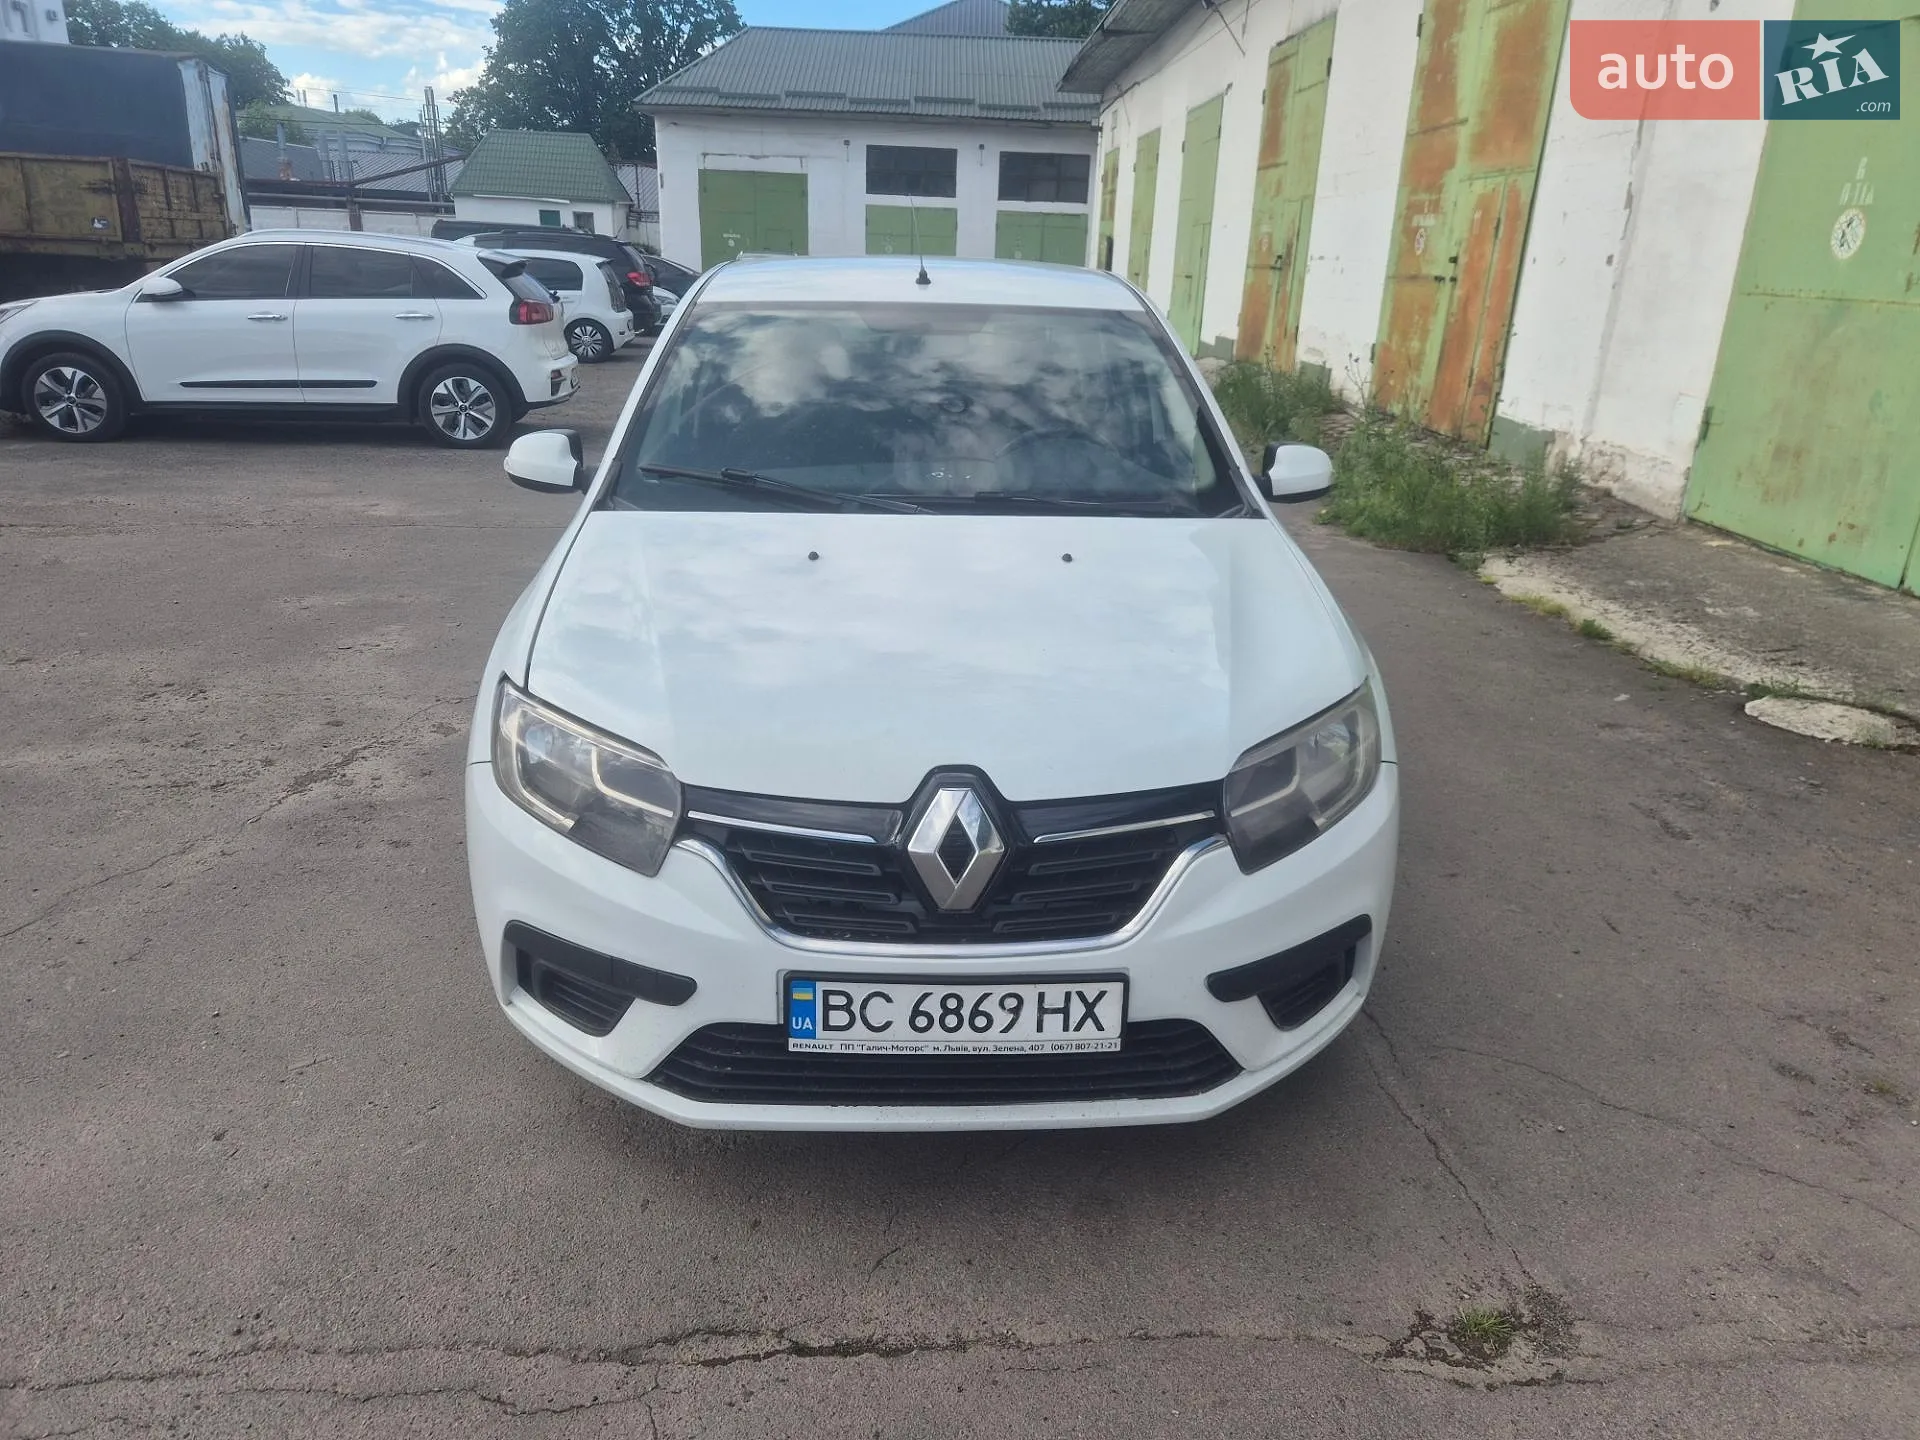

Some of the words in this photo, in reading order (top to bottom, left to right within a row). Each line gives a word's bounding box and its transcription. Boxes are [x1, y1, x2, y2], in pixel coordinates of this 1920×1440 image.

[822, 989, 894, 1034] BC
[908, 991, 1025, 1034] 6869
[1036, 990, 1108, 1033] HX
[792, 1016, 813, 1030] UA
[1050, 1043, 1073, 1051] (067)
[1075, 1041, 1118, 1050] 807-21-21
